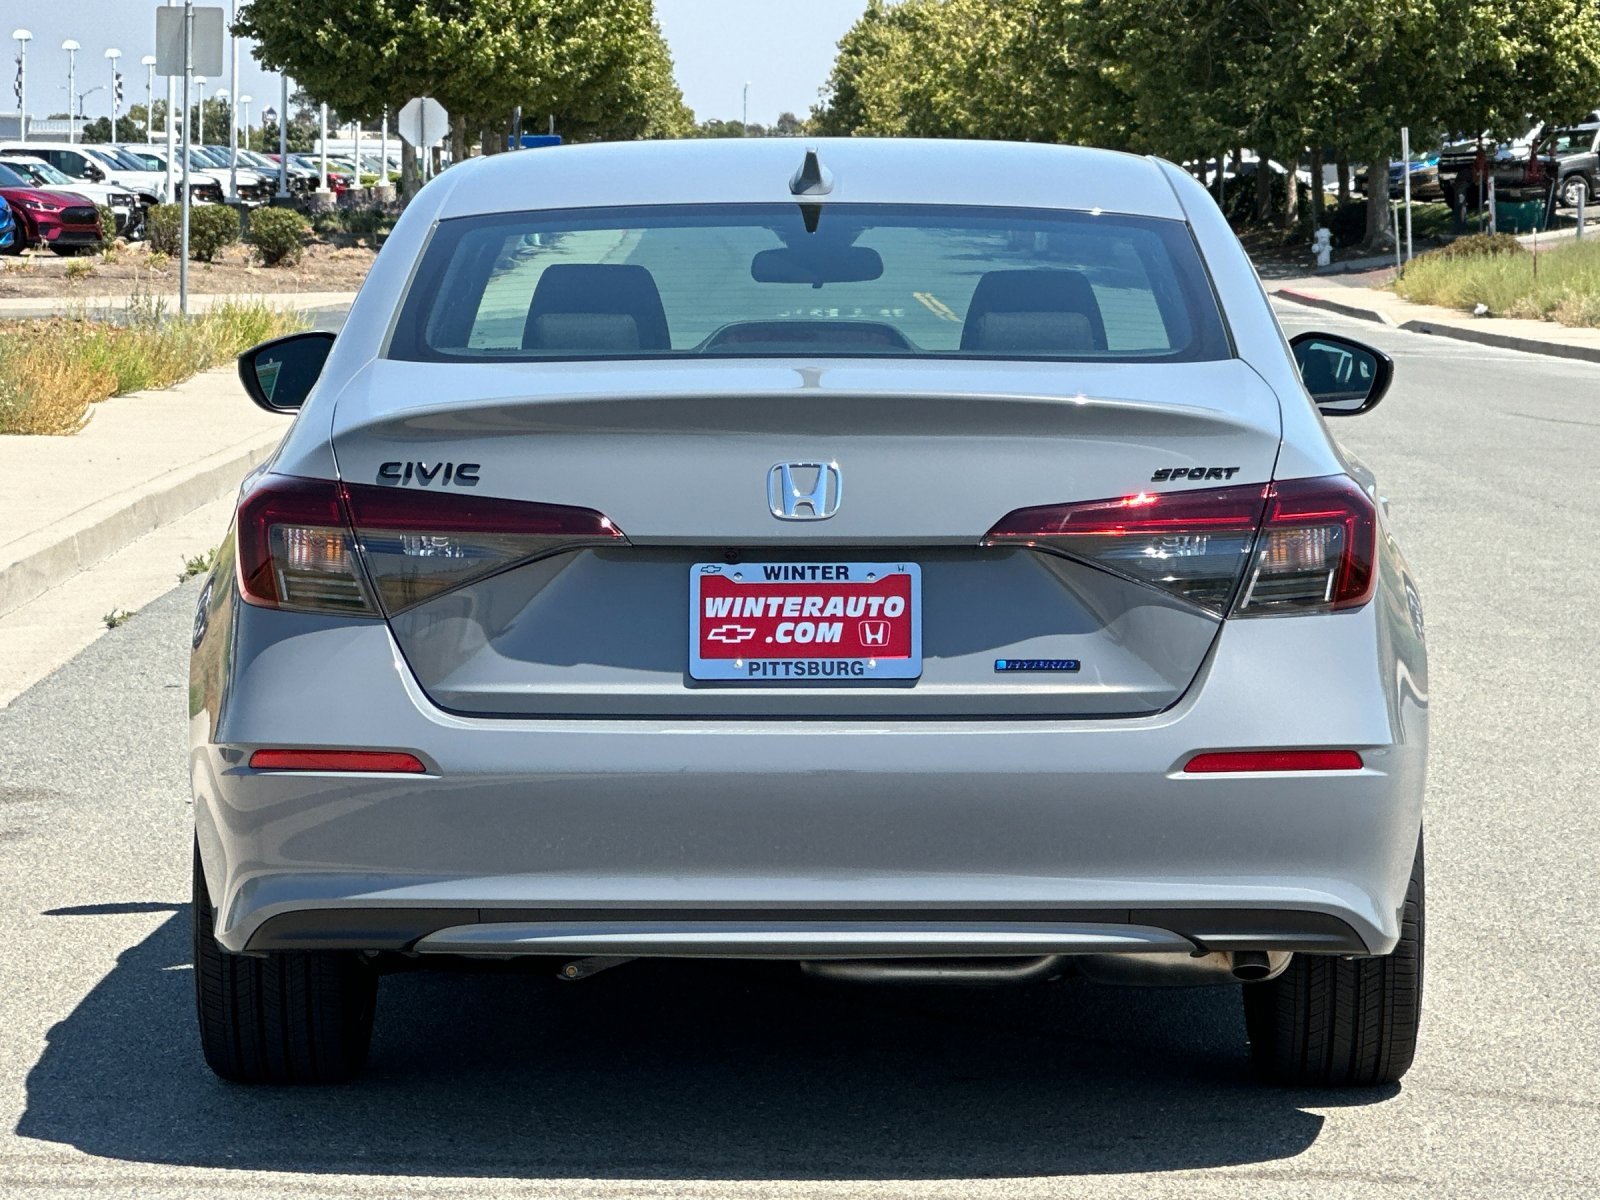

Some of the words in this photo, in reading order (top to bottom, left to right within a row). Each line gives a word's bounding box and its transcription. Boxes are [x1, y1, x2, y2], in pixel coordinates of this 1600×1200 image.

[379, 461, 481, 479] CIVIC
[1151, 467, 1241, 482] SPORT
[763, 565, 849, 580] WINTER
[705, 596, 905, 618] WINTERAUTO
[765, 622, 843, 643] .COM
[748, 661, 864, 676] PITTSBURG
[1007, 661, 1076, 669] HYBRID
